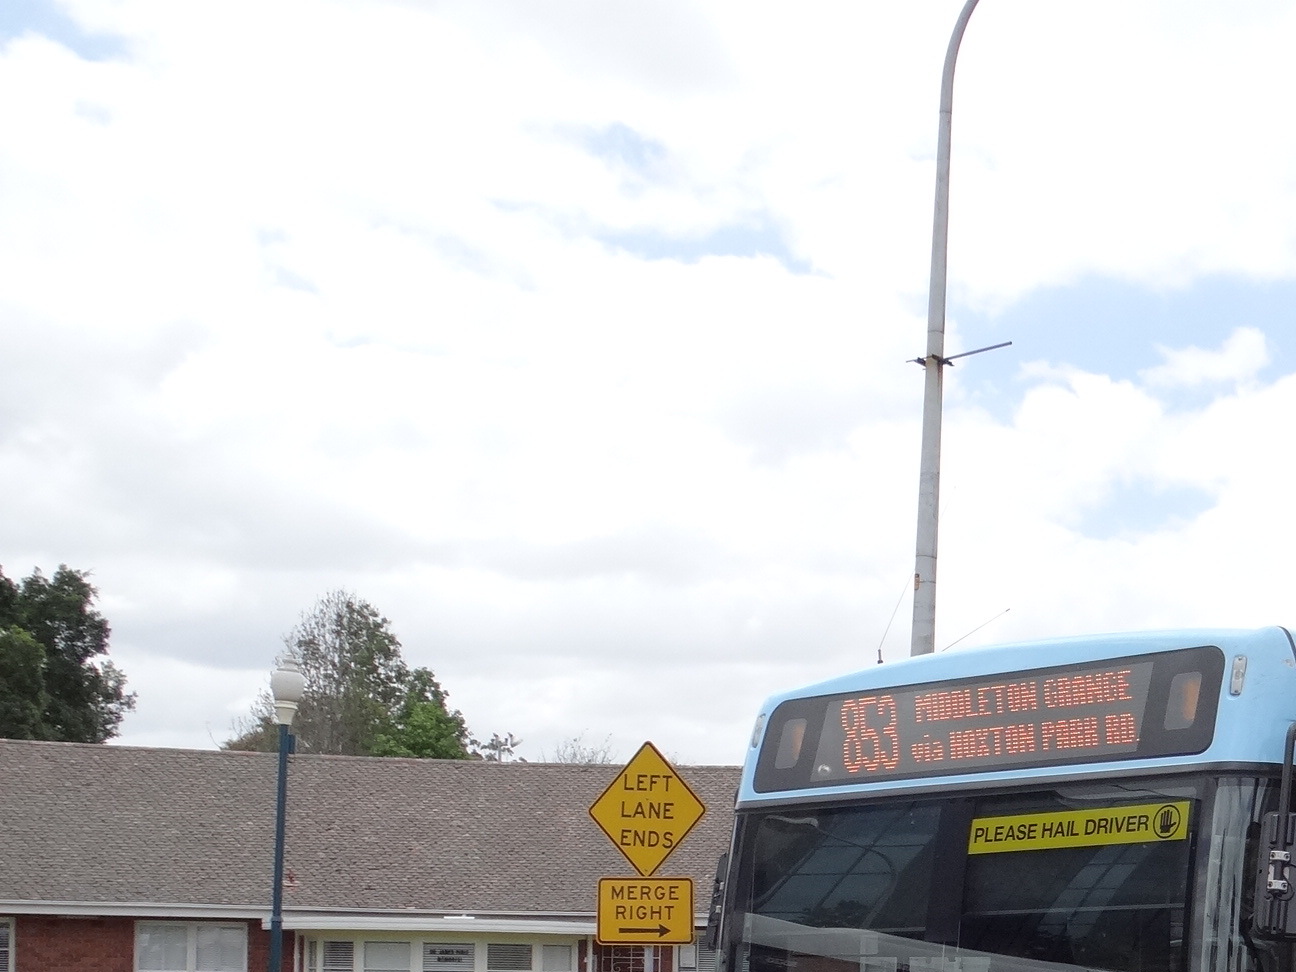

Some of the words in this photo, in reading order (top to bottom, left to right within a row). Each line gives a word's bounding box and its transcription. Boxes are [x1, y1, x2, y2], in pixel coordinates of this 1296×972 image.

[914, 680, 1037, 723] MIDDLETON
[1043, 670, 1133, 709] GRANGE
[840, 694, 901, 774] 853
[911, 733, 944, 763] via
[949, 723, 1036, 760] HOXTON
[1042, 717, 1099, 750] PARK
[623, 773, 673, 792] LEFT
[621, 801, 675, 820] LANE
[620, 829, 674, 849] ENDS
[973, 818, 1037, 844] PLEASE
[1041, 818, 1081, 840] HAIL
[1084, 814, 1149, 835] DRIVER
[611, 886, 679, 900] MERGE
[615, 905, 674, 920] RIGHT
